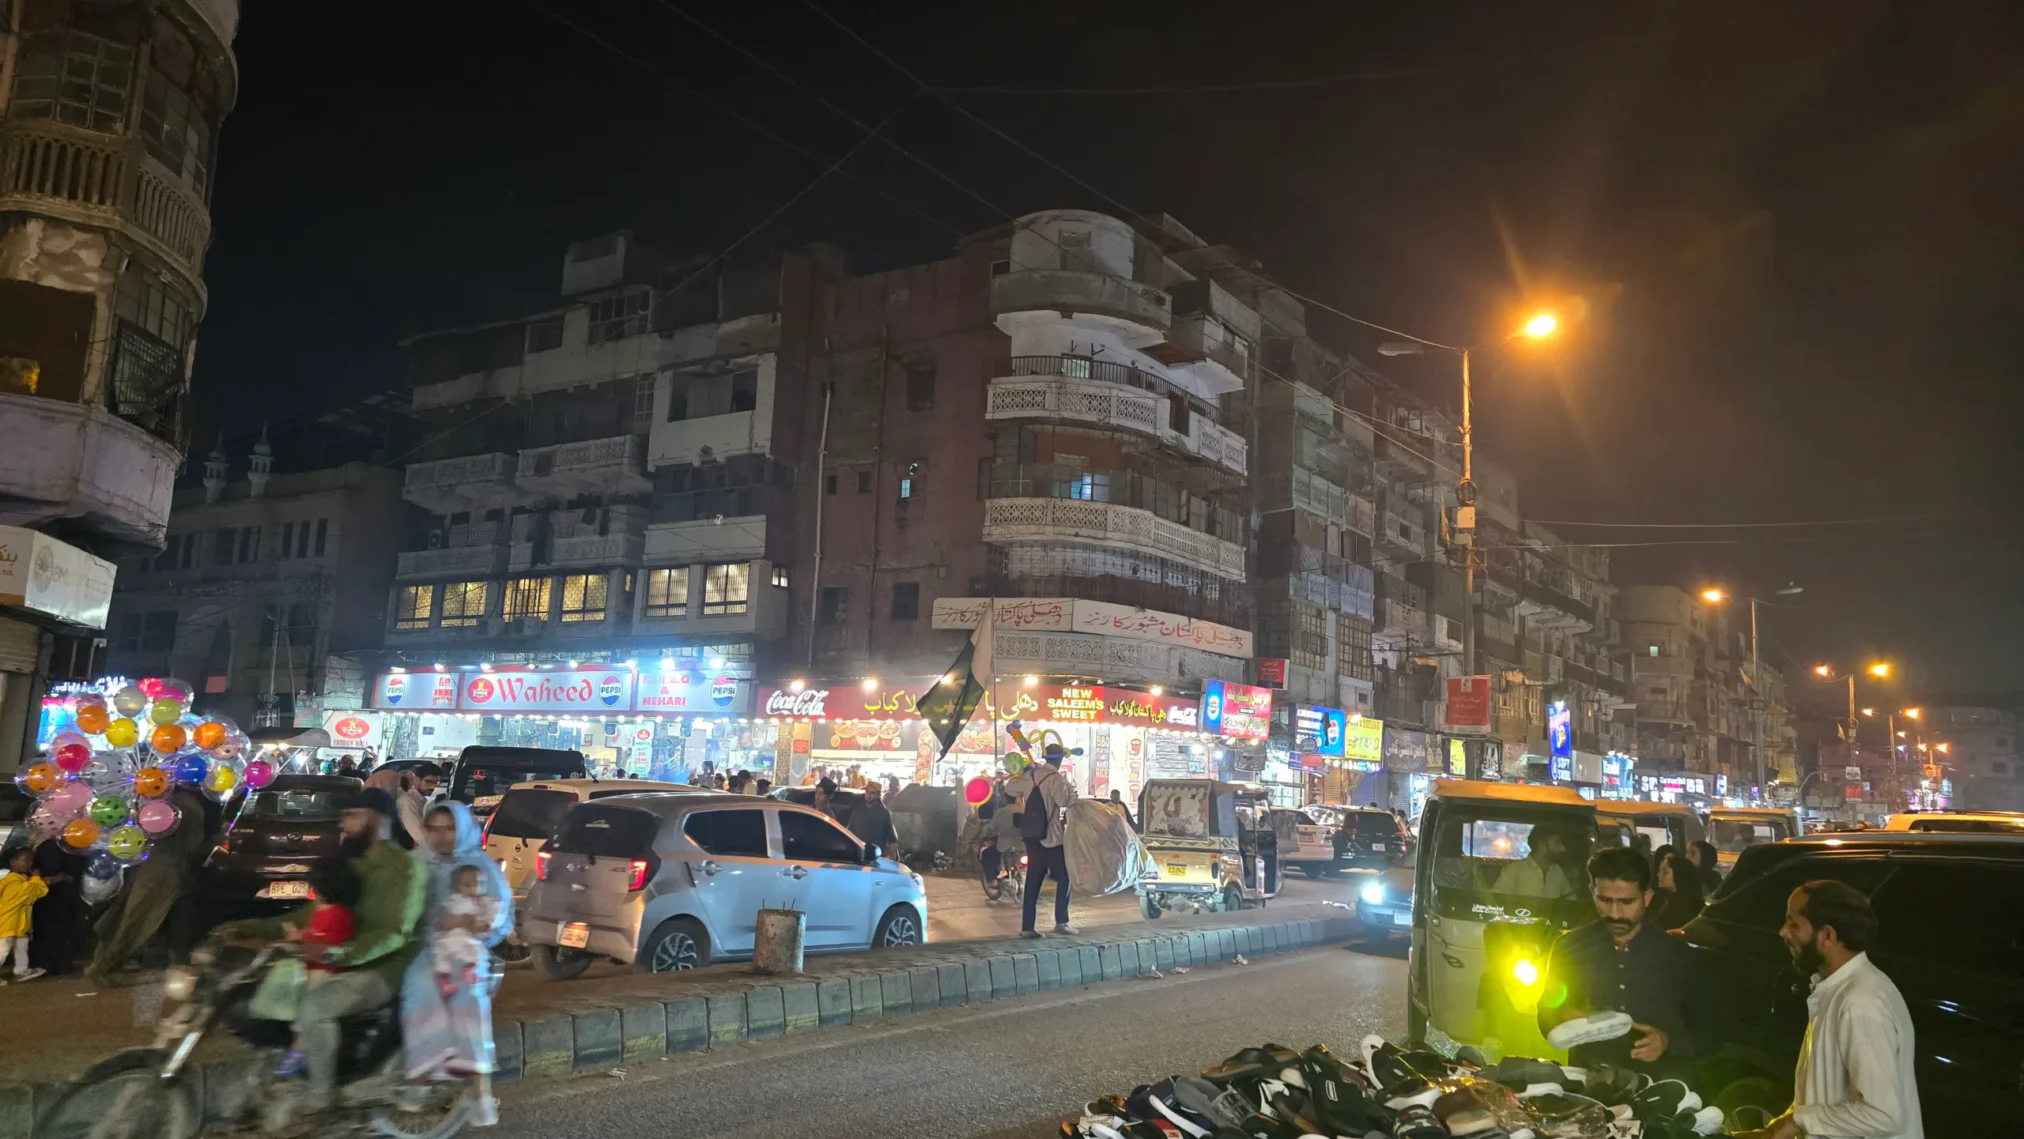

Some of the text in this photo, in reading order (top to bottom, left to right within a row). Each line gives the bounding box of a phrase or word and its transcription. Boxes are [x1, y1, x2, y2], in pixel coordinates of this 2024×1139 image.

[497, 677, 593, 703] Waheed
[600, 686, 621, 694] PEPSI
[660, 686, 670, 695] &
[712, 687, 735, 695] PEPSI
[1062, 688, 1093, 699] NEW
[642, 697, 686, 706] NEHARI
[864, 690, 905, 716] کباب
[1047, 697, 1105, 710] SALEEM'S
[1052, 709, 1097, 720] SWEET
[271, 884, 286, 895] BPE
